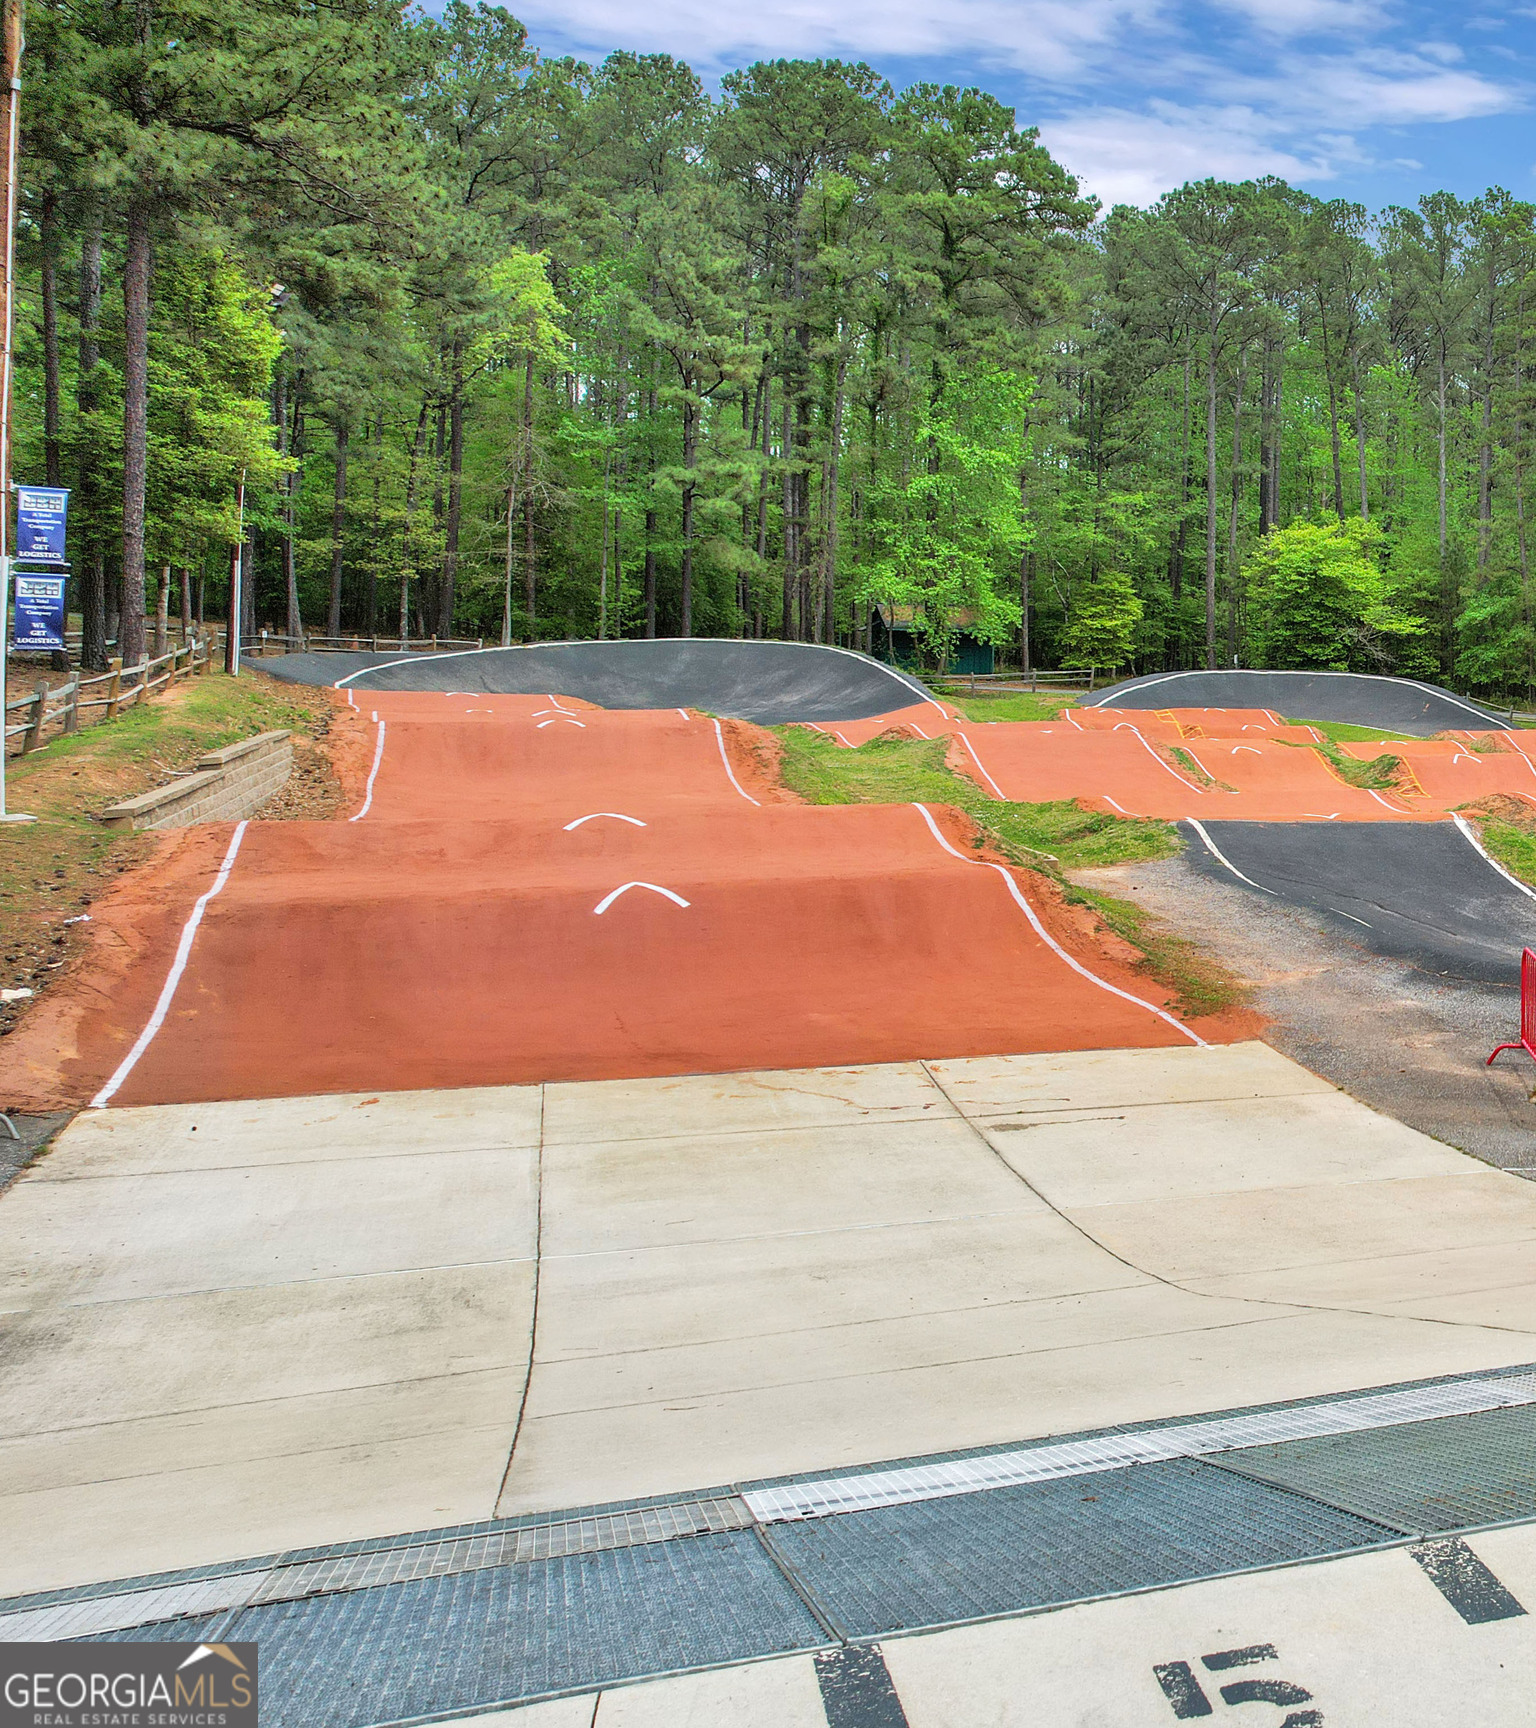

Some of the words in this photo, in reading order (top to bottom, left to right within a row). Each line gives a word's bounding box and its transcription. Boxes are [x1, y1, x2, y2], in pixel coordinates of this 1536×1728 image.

[21, 517, 62, 525] Transportation
[19, 551, 62, 559] LOGISTICS
[1152, 1643, 1325, 1728] 5
